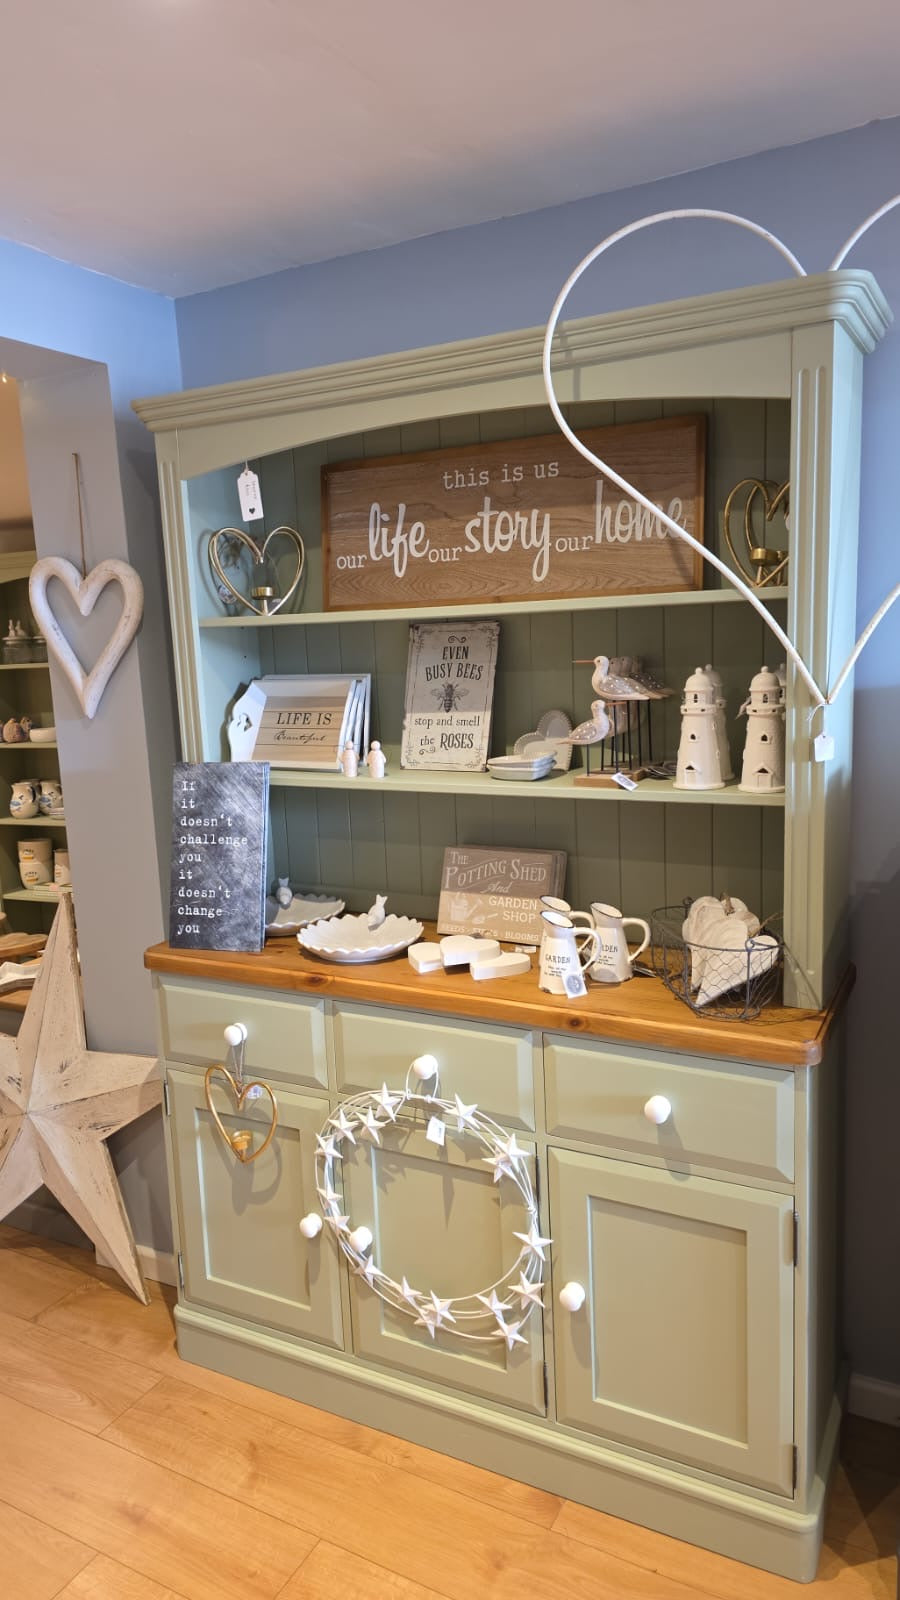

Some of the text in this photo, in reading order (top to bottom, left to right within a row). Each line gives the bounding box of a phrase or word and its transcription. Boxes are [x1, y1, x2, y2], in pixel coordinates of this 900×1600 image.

[443, 461, 560, 489] this is us
[336, 480, 687, 582] our life our story our home
[442, 646, 469, 660] EVEN
[425, 662, 484, 681] BUSY BEES
[276, 712, 332, 726] LIFE IS
[414, 716, 480, 729] stop and smell
[420, 733, 474, 750] the ROSES
[181, 780, 196, 791] If
[180, 798, 195, 809] it
[180, 813, 233, 827] doesn't
[180, 834, 248, 847] challenge
[179, 854, 202, 864] you
[178, 869, 193, 880] it
[178, 886, 232, 898] doesn't
[480, 881, 513, 894] And
[488, 895, 537, 910] GARDEN
[177, 905, 223, 918] change
[502, 911, 536, 923] SHOP
[177, 924, 200, 934] you
[545, 953, 571, 964] GARDEN
